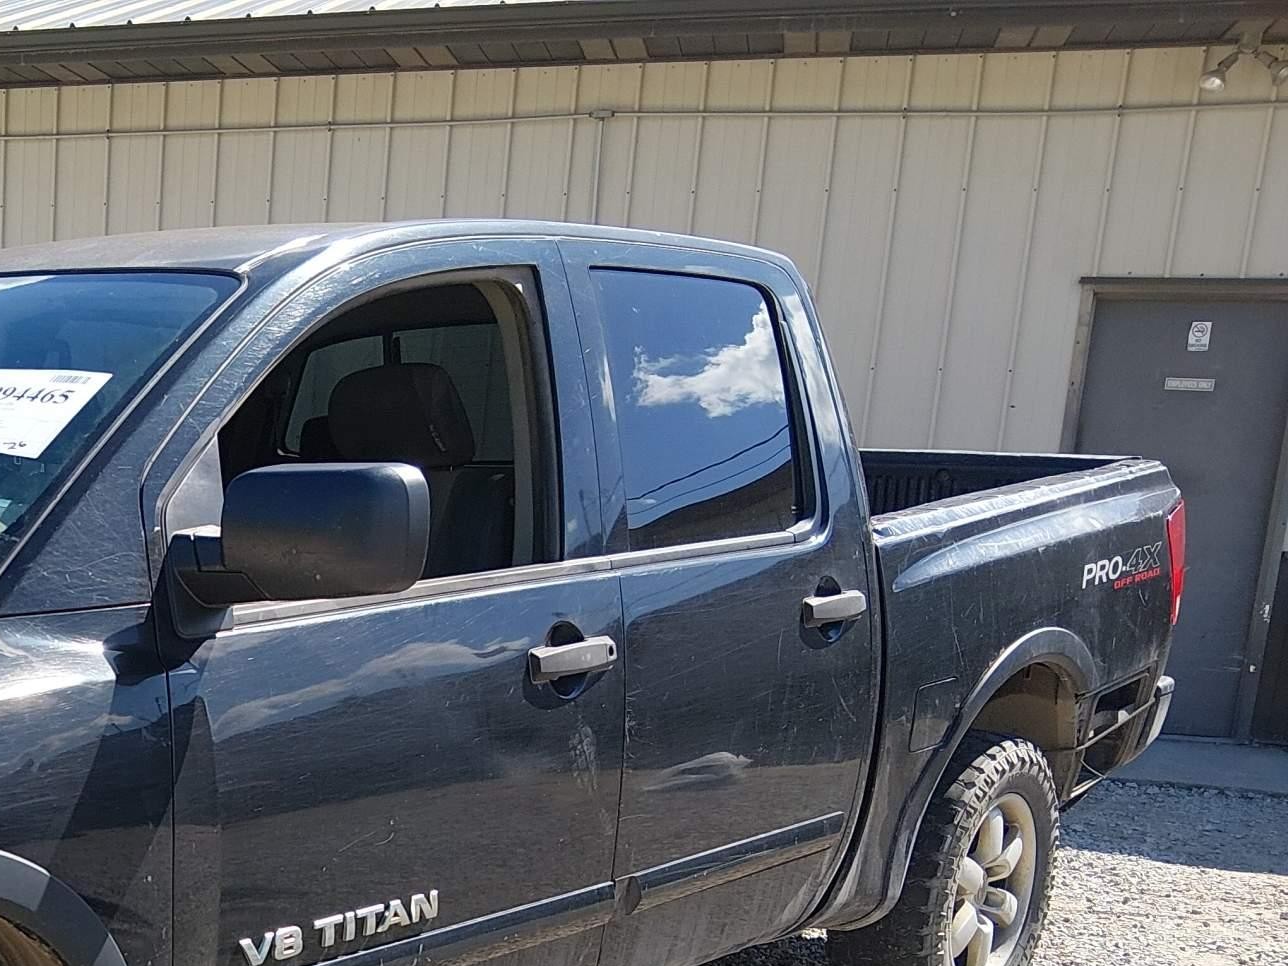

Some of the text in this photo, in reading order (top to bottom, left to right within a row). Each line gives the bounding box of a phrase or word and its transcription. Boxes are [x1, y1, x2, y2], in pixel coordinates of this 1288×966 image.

[1114, 567, 1160, 590] OFF ROAD
[239, 889, 439, 966] V8 TITAN
